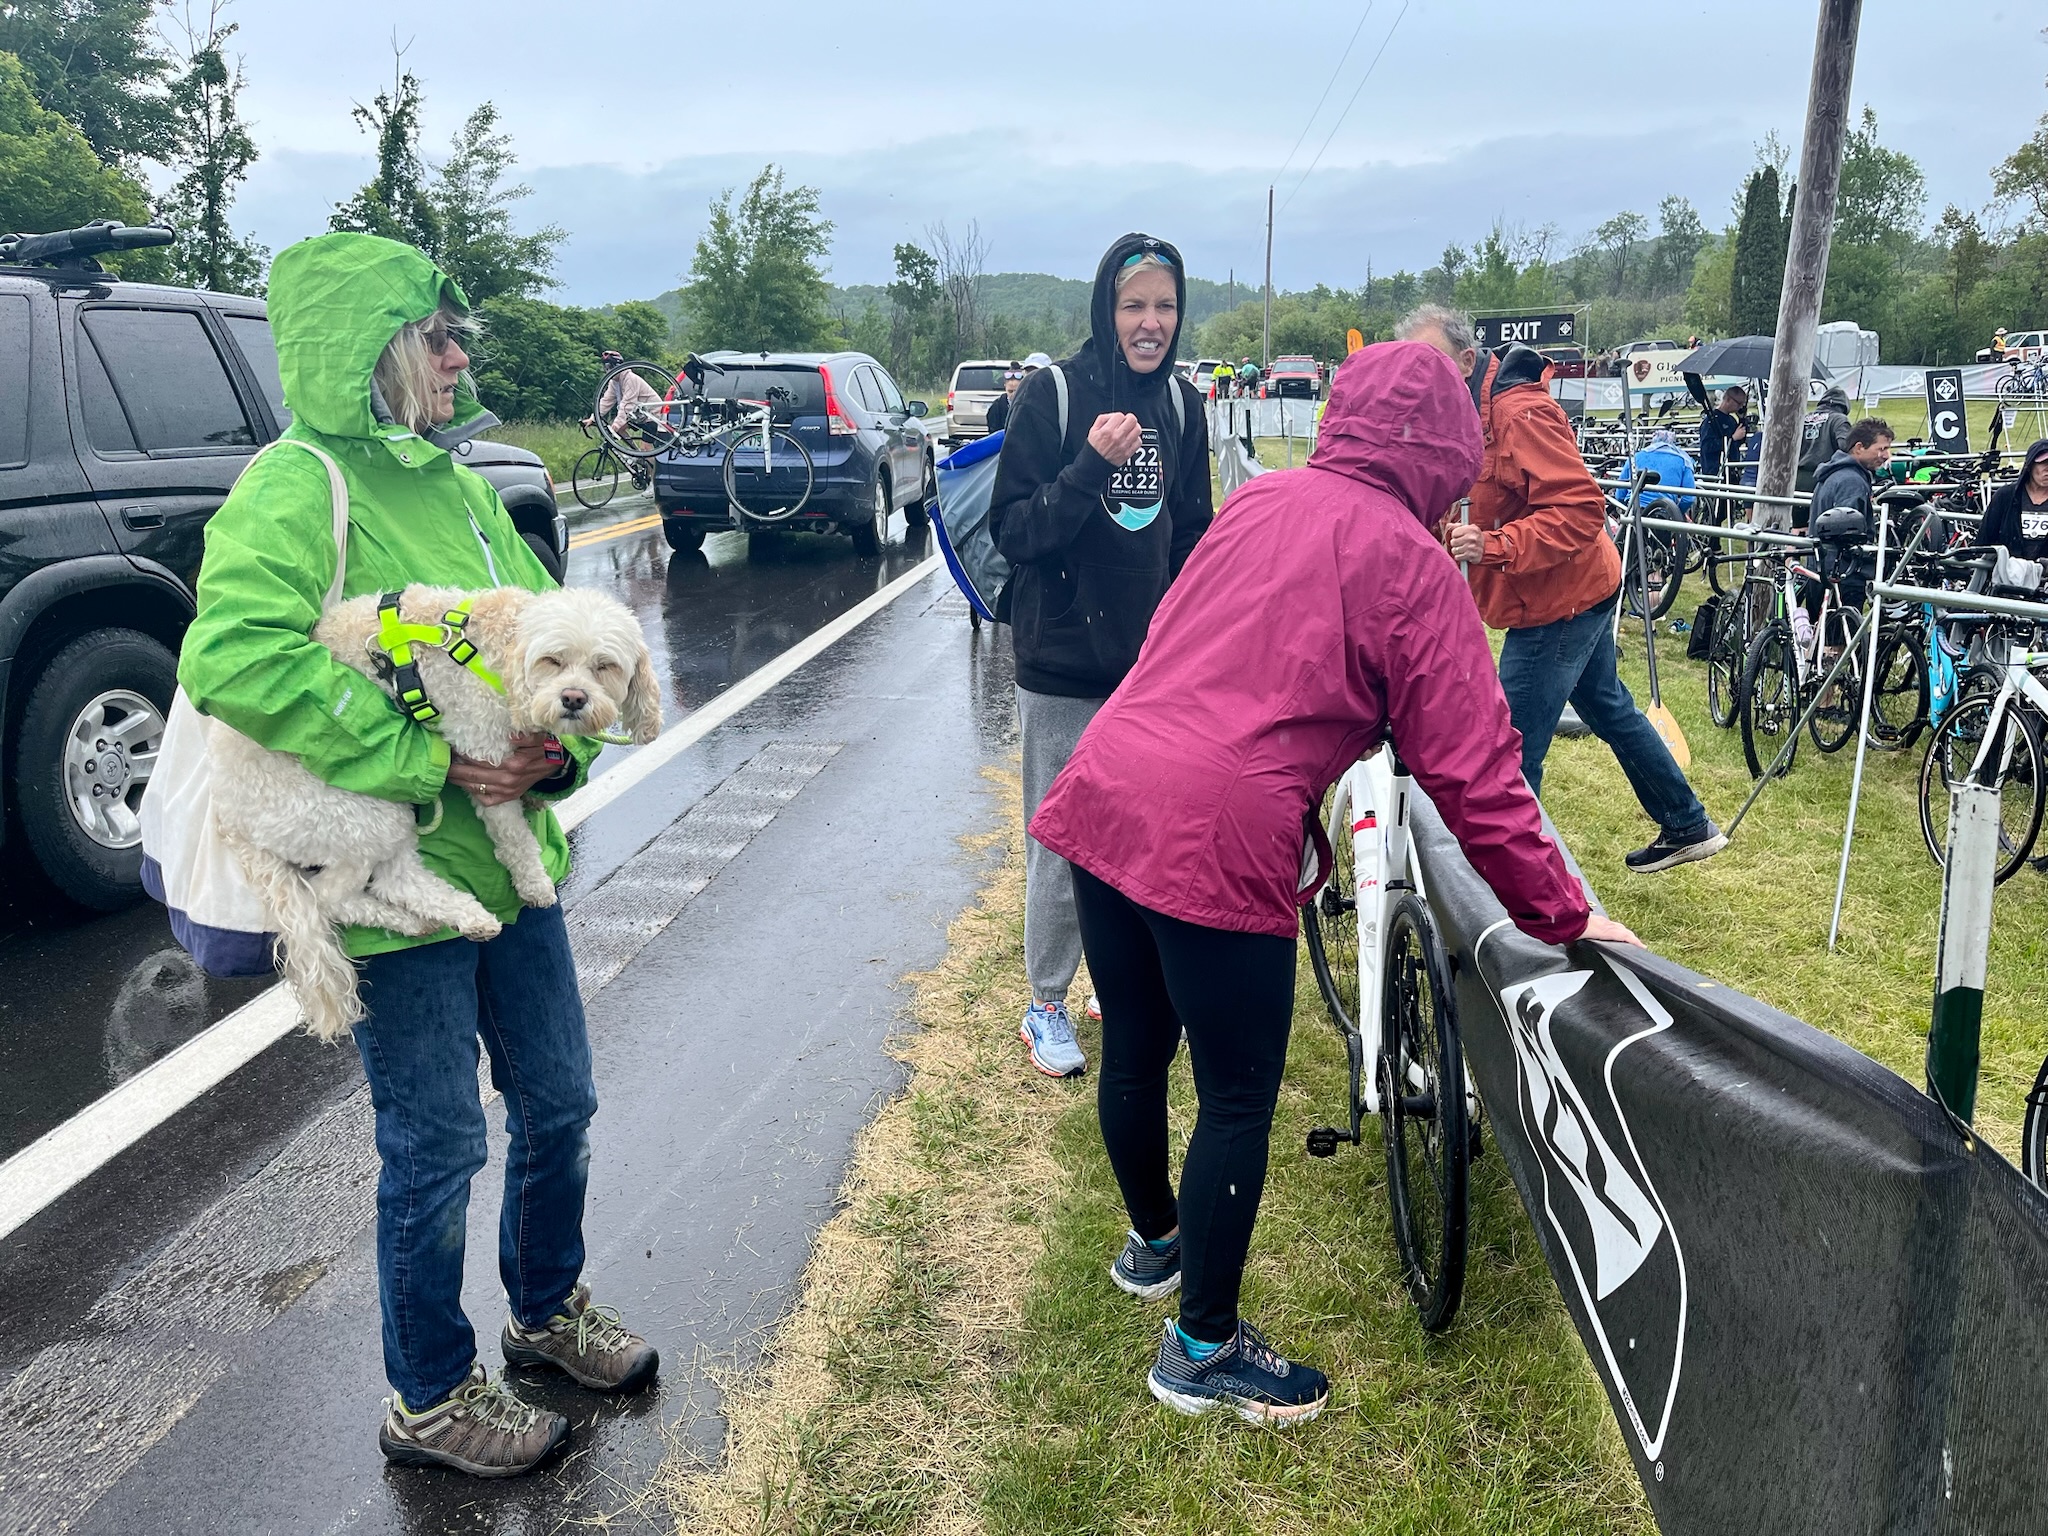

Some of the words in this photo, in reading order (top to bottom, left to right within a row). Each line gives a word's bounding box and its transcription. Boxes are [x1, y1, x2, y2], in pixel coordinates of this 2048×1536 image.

[1501, 321, 1541, 341] EXIT
[1940, 386, 1952, 395] 22
[1934, 411, 1960, 439] C
